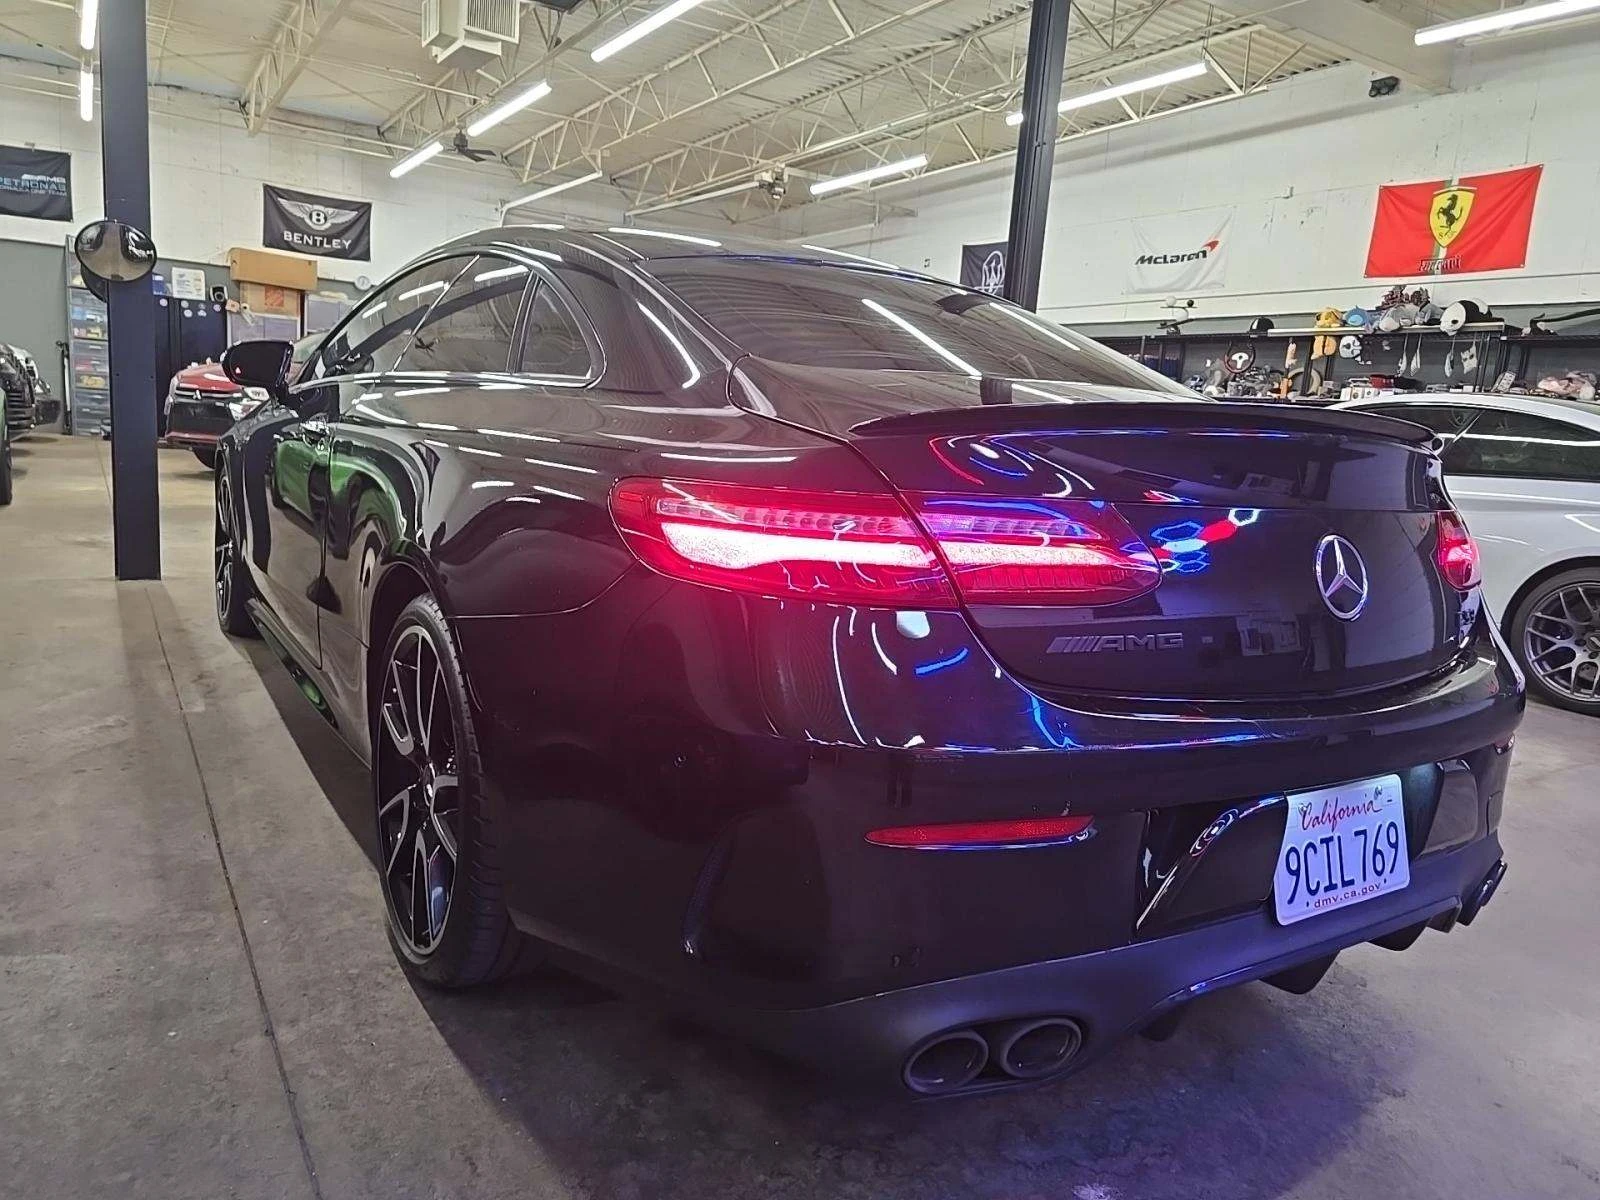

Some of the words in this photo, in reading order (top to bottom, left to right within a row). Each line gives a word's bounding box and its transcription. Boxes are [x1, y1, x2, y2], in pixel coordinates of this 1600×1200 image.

[283, 230, 352, 250] BENTLEY
[1135, 249, 1208, 265] McLaren
[1093, 632, 1184, 652] AMG
[1300, 795, 1383, 832] California
[1314, 883, 1382, 908] dmv.ca.gov
